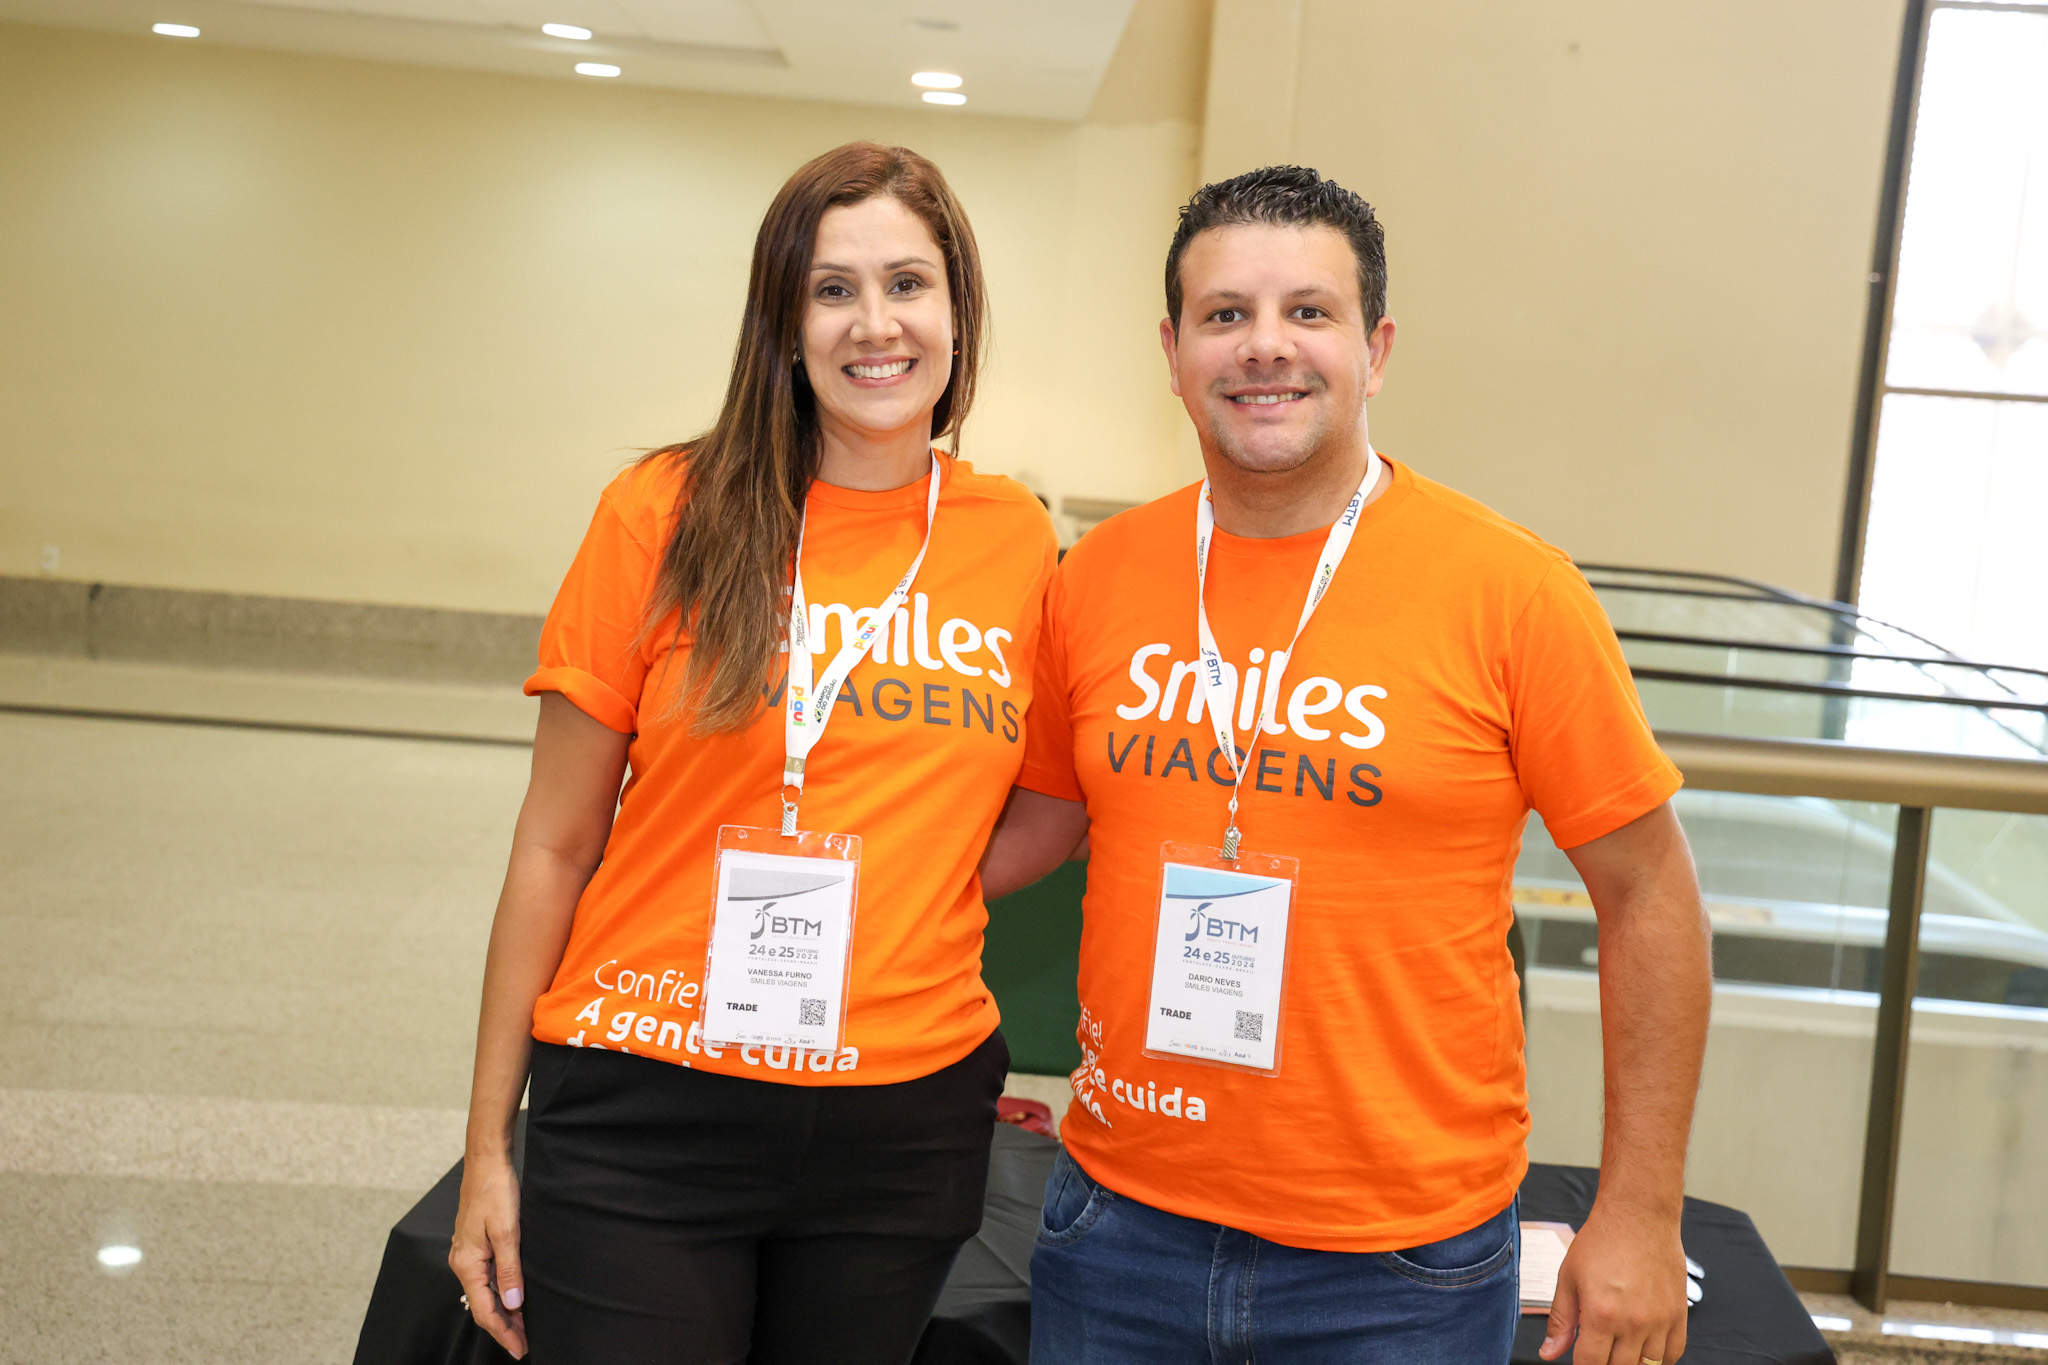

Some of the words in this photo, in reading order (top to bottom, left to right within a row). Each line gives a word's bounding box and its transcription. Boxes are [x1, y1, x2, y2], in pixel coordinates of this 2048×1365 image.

[1342, 500, 1359, 526] BTM
[1207, 659, 1222, 686] BTM
[761, 669, 1019, 744] VAGENS
[816, 685, 829, 708] CAMPOS
[821, 701, 828, 710] DO
[826, 679, 837, 702] JORDÃO
[1116, 643, 1388, 749] Smiles
[1108, 732, 1383, 807] VIAGENS
[772, 916, 822, 936] BTM
[1207, 918, 1258, 943] BTM
[749, 944, 766, 956] 24
[769, 948, 776, 956] e
[778, 946, 794, 958] 25
[1184, 946, 1200, 959] 24
[1203, 952, 1211, 961] e
[1214, 951, 1230, 964] 25
[748, 968, 783, 977] VANESSA
[1189, 973, 1213, 983] DARIO
[1215, 978, 1241, 988] NEVES
[1185, 982, 1210, 992] SMILES
[1212, 986, 1243, 997] VIAGENS
[575, 997, 605, 1026] A
[727, 1002, 758, 1011] TRADE
[1160, 1007, 1192, 1020] TRADE
[1112, 1078, 1206, 1121] cuida
